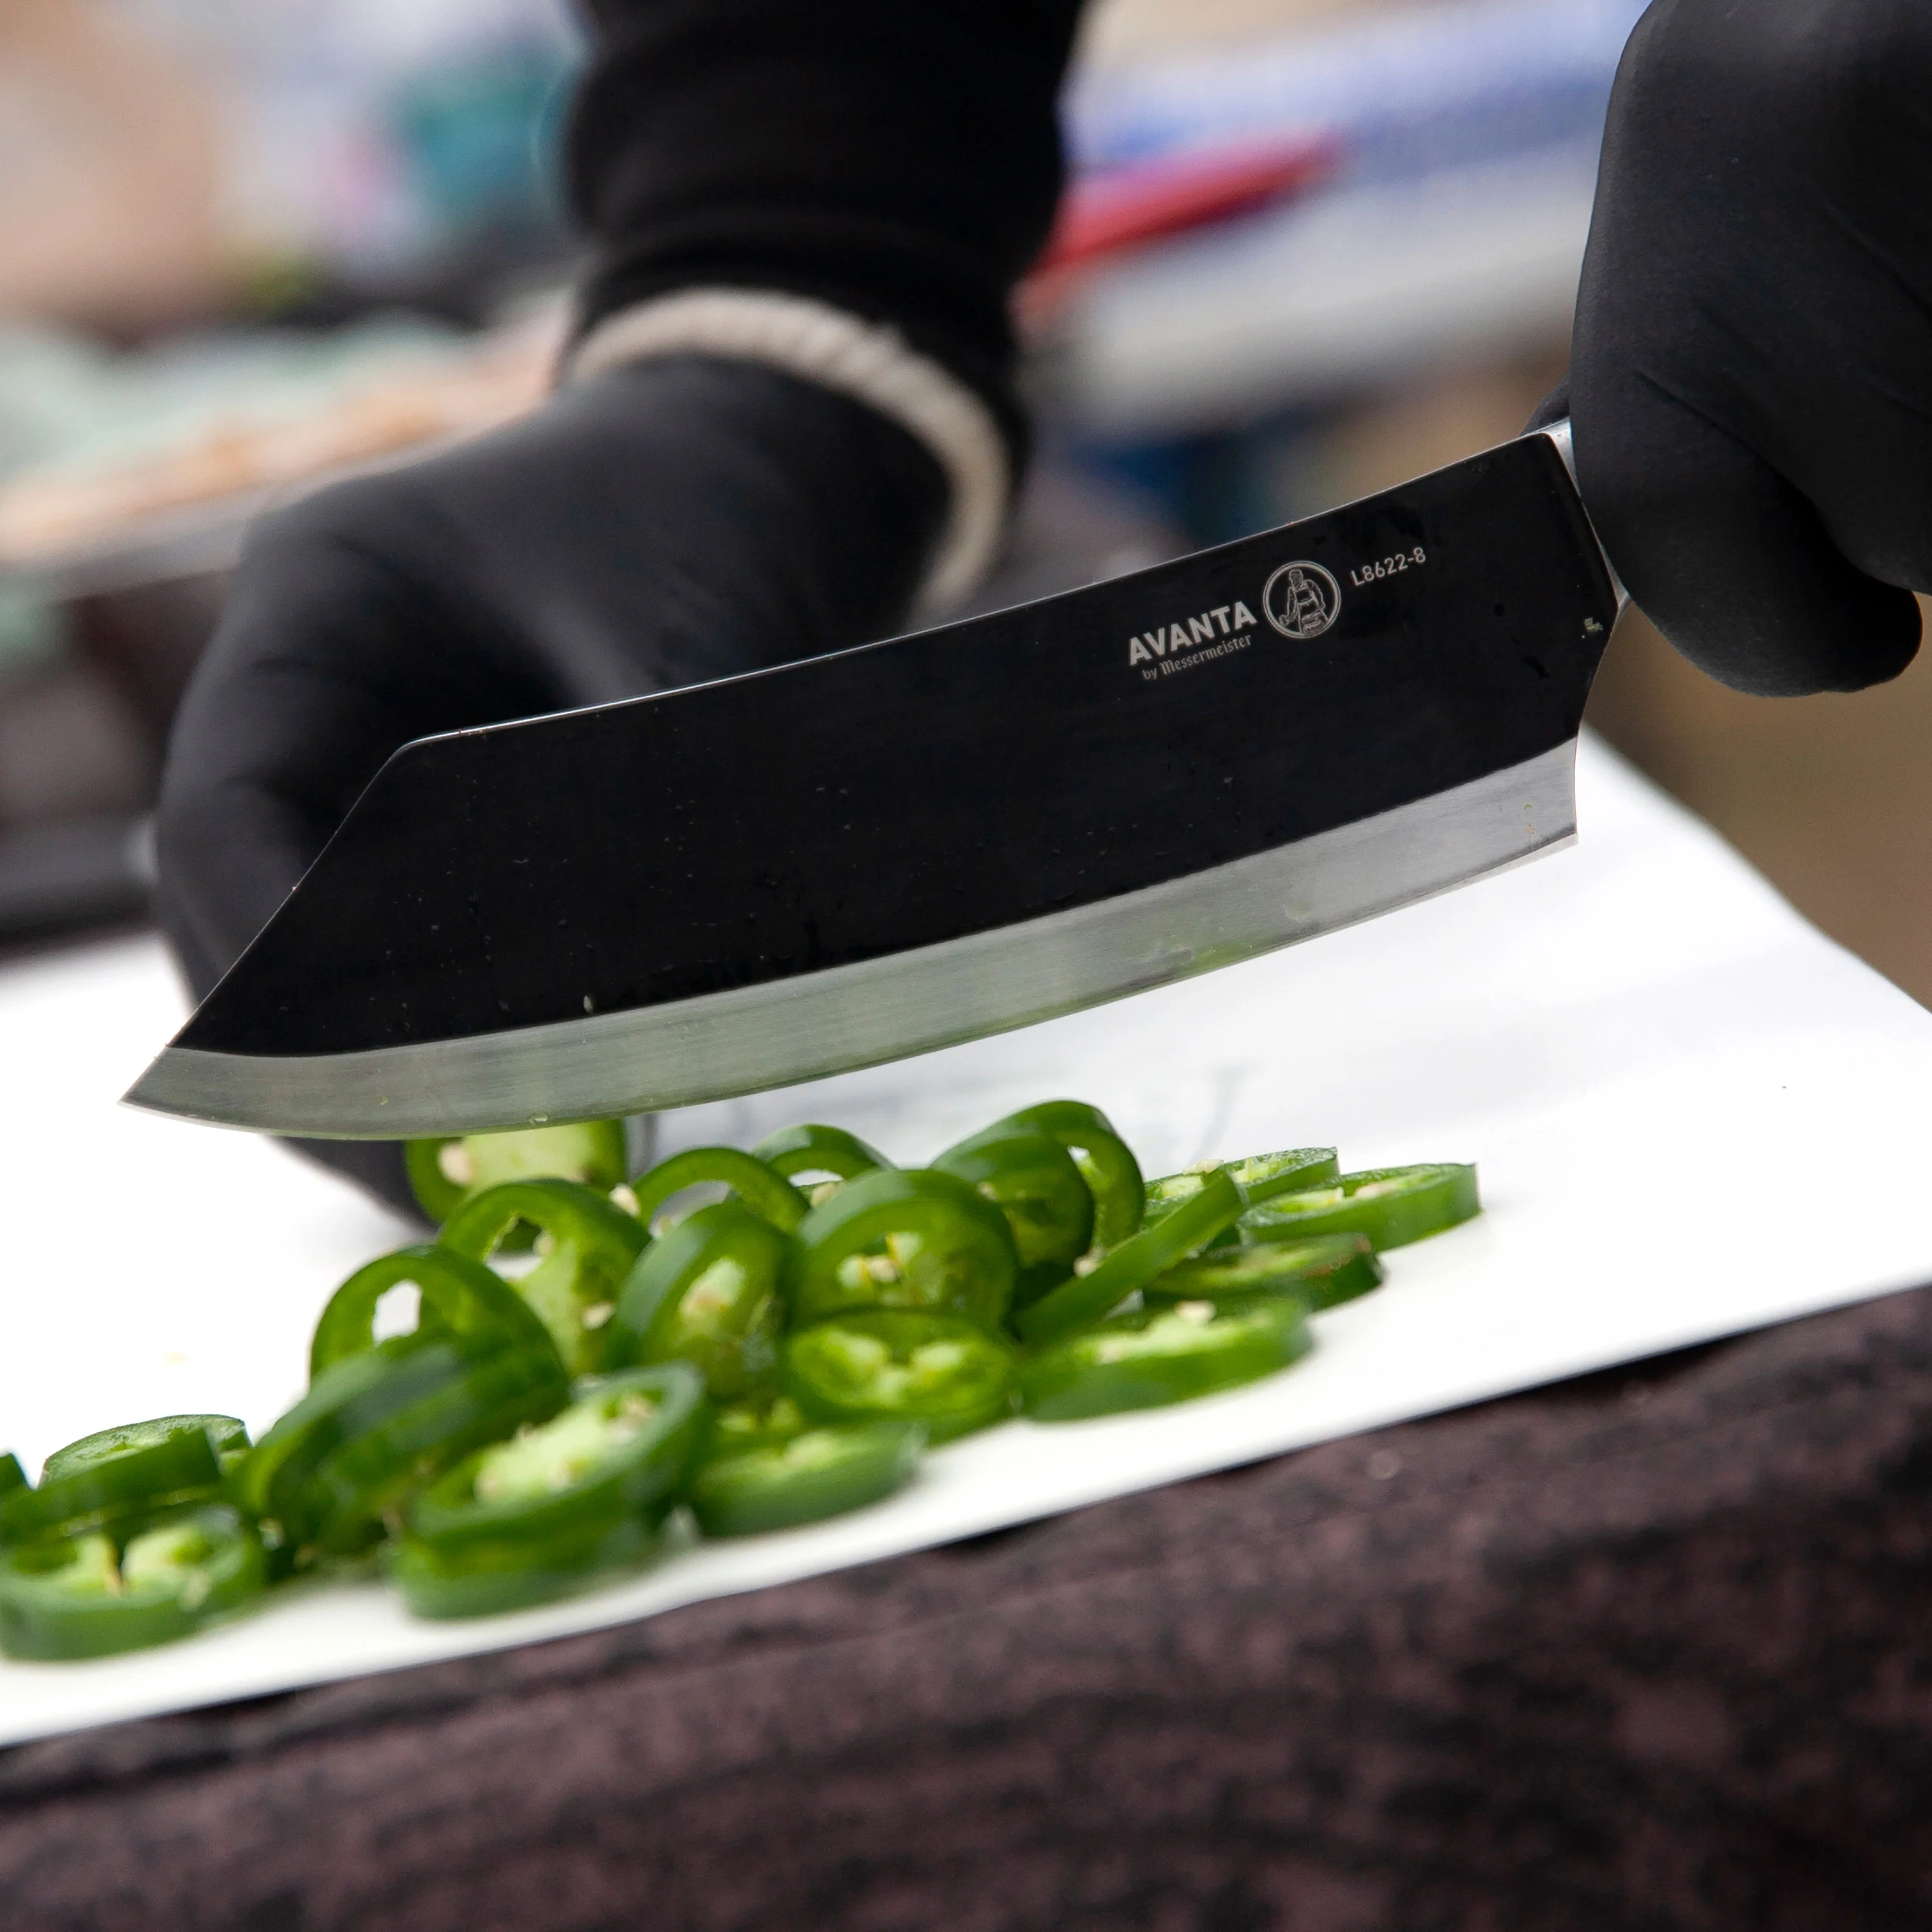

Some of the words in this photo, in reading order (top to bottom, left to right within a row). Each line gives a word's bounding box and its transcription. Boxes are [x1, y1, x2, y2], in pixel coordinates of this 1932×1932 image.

[1350, 547, 1426, 587] L8622-8
[1129, 601, 1257, 665] AVANTA
[1142, 667, 1158, 680] by
[1160, 634, 1251, 675] Messermeister
